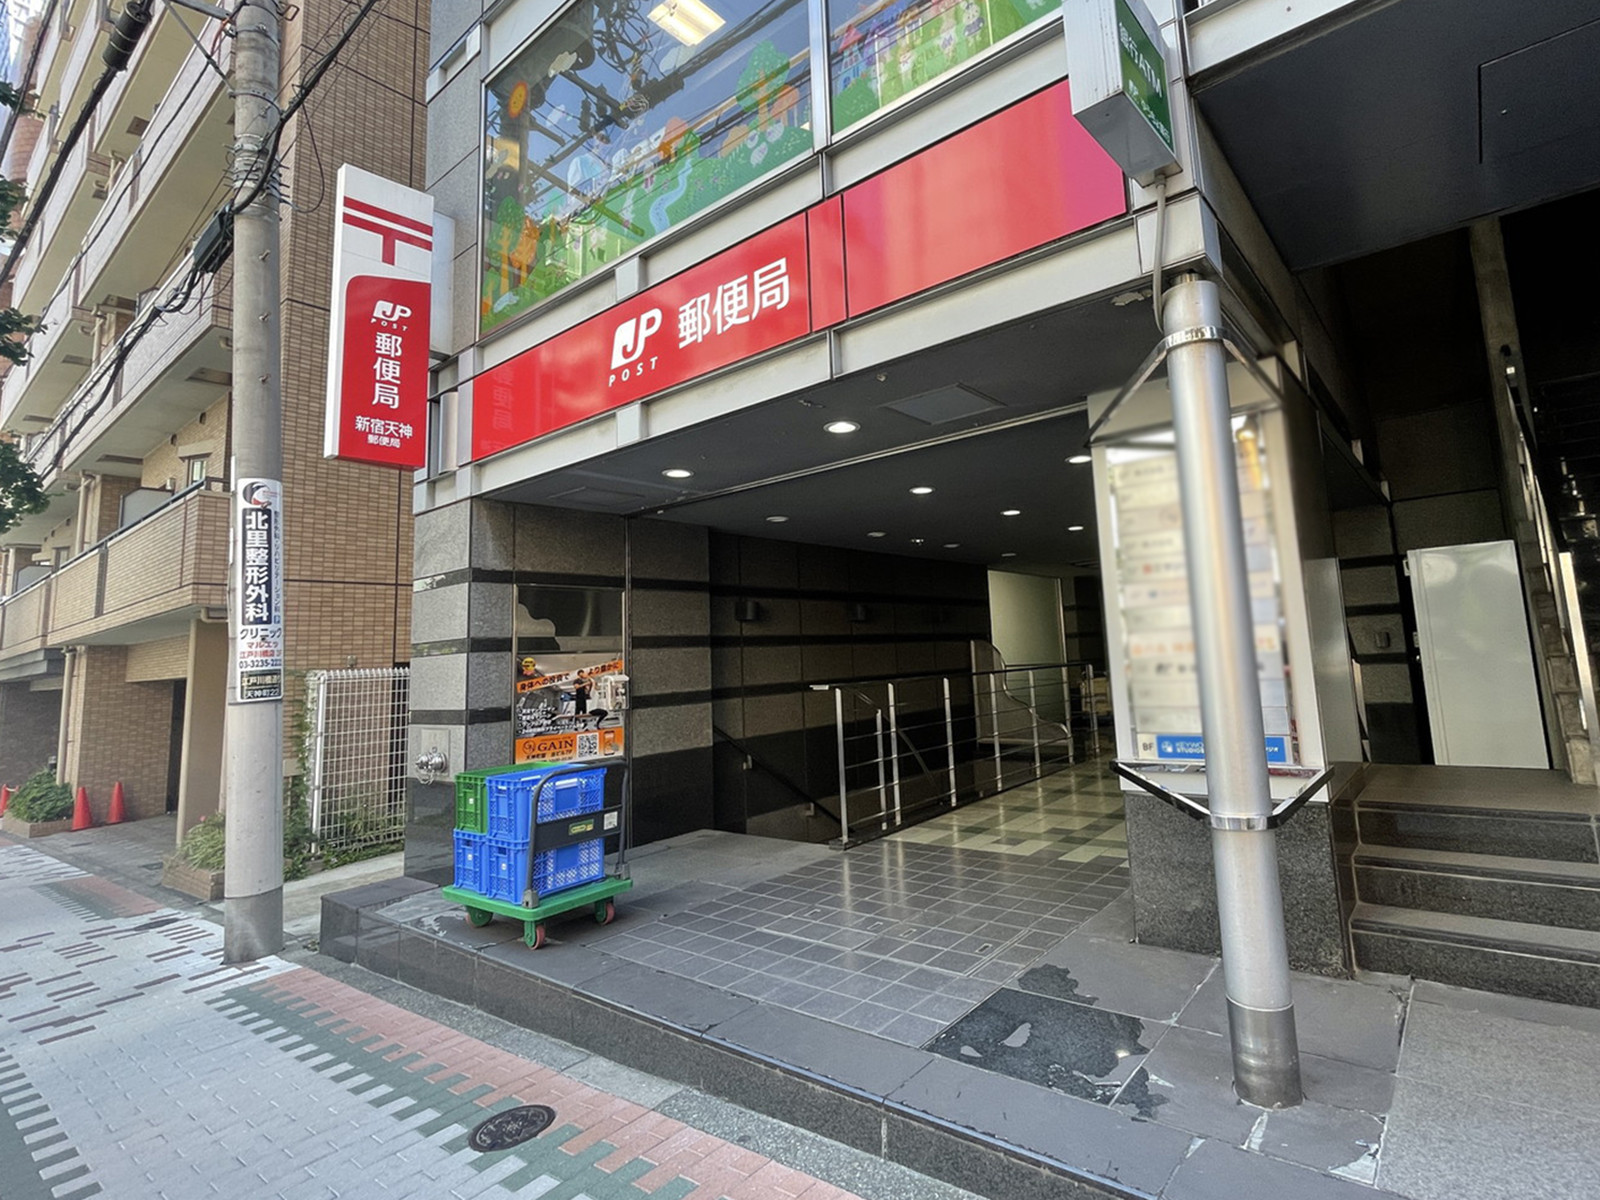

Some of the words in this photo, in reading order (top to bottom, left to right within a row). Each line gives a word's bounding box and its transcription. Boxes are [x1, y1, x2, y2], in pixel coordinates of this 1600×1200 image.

[677, 257, 791, 349] 郵便局
[370, 318, 409, 331] POST
[372, 332, 402, 410] 郵便局
[608, 356, 659, 387] POST
[355, 415, 413, 439] 新宿天神
[367, 434, 401, 449] 郵便局
[245, 511, 269, 622] 北里整形外科
[240, 627, 282, 640] クリニック
[537, 739, 574, 752] GAIN
[1142, 742, 1154, 751] BF
